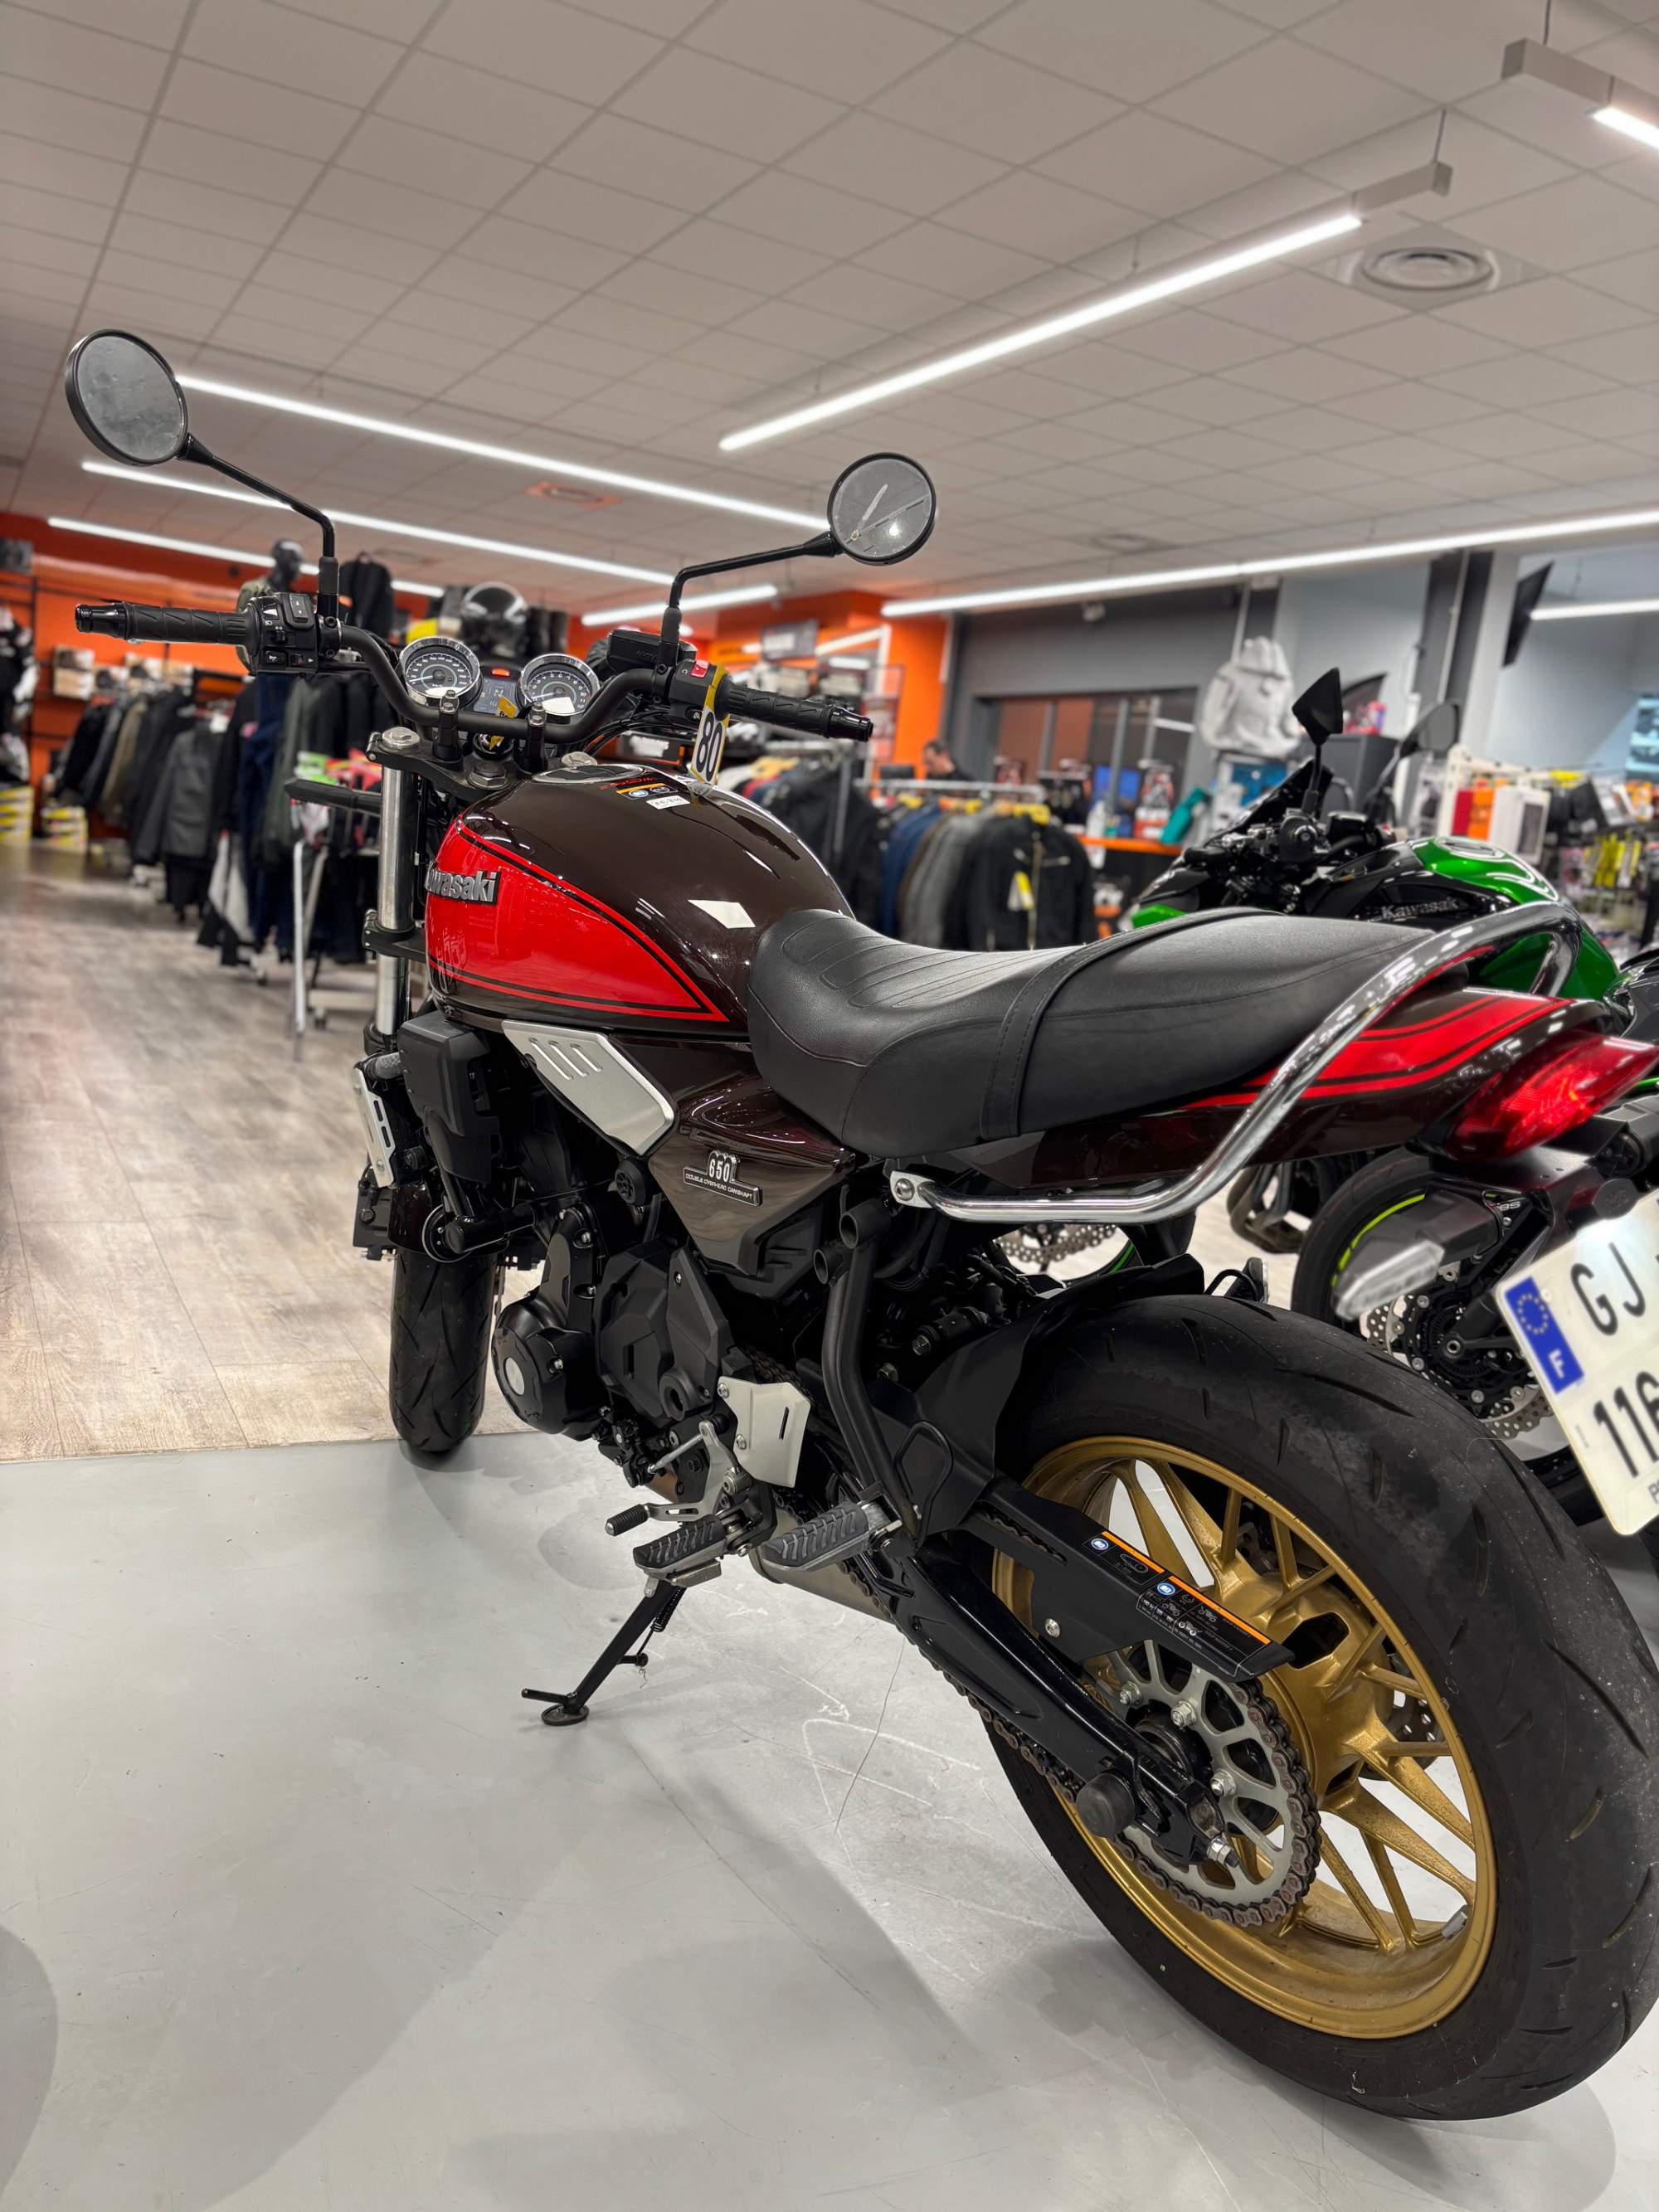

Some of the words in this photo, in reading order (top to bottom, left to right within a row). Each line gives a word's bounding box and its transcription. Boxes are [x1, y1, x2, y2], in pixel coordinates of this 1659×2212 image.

[695, 712, 723, 781] 80
[424, 860, 498, 902] wasaki
[1381, 897, 1462, 919] Kawasak
[709, 1158, 730, 1182] 650
[1496, 1201, 1520, 1212] BS
[1548, 1349, 1566, 1378] F
